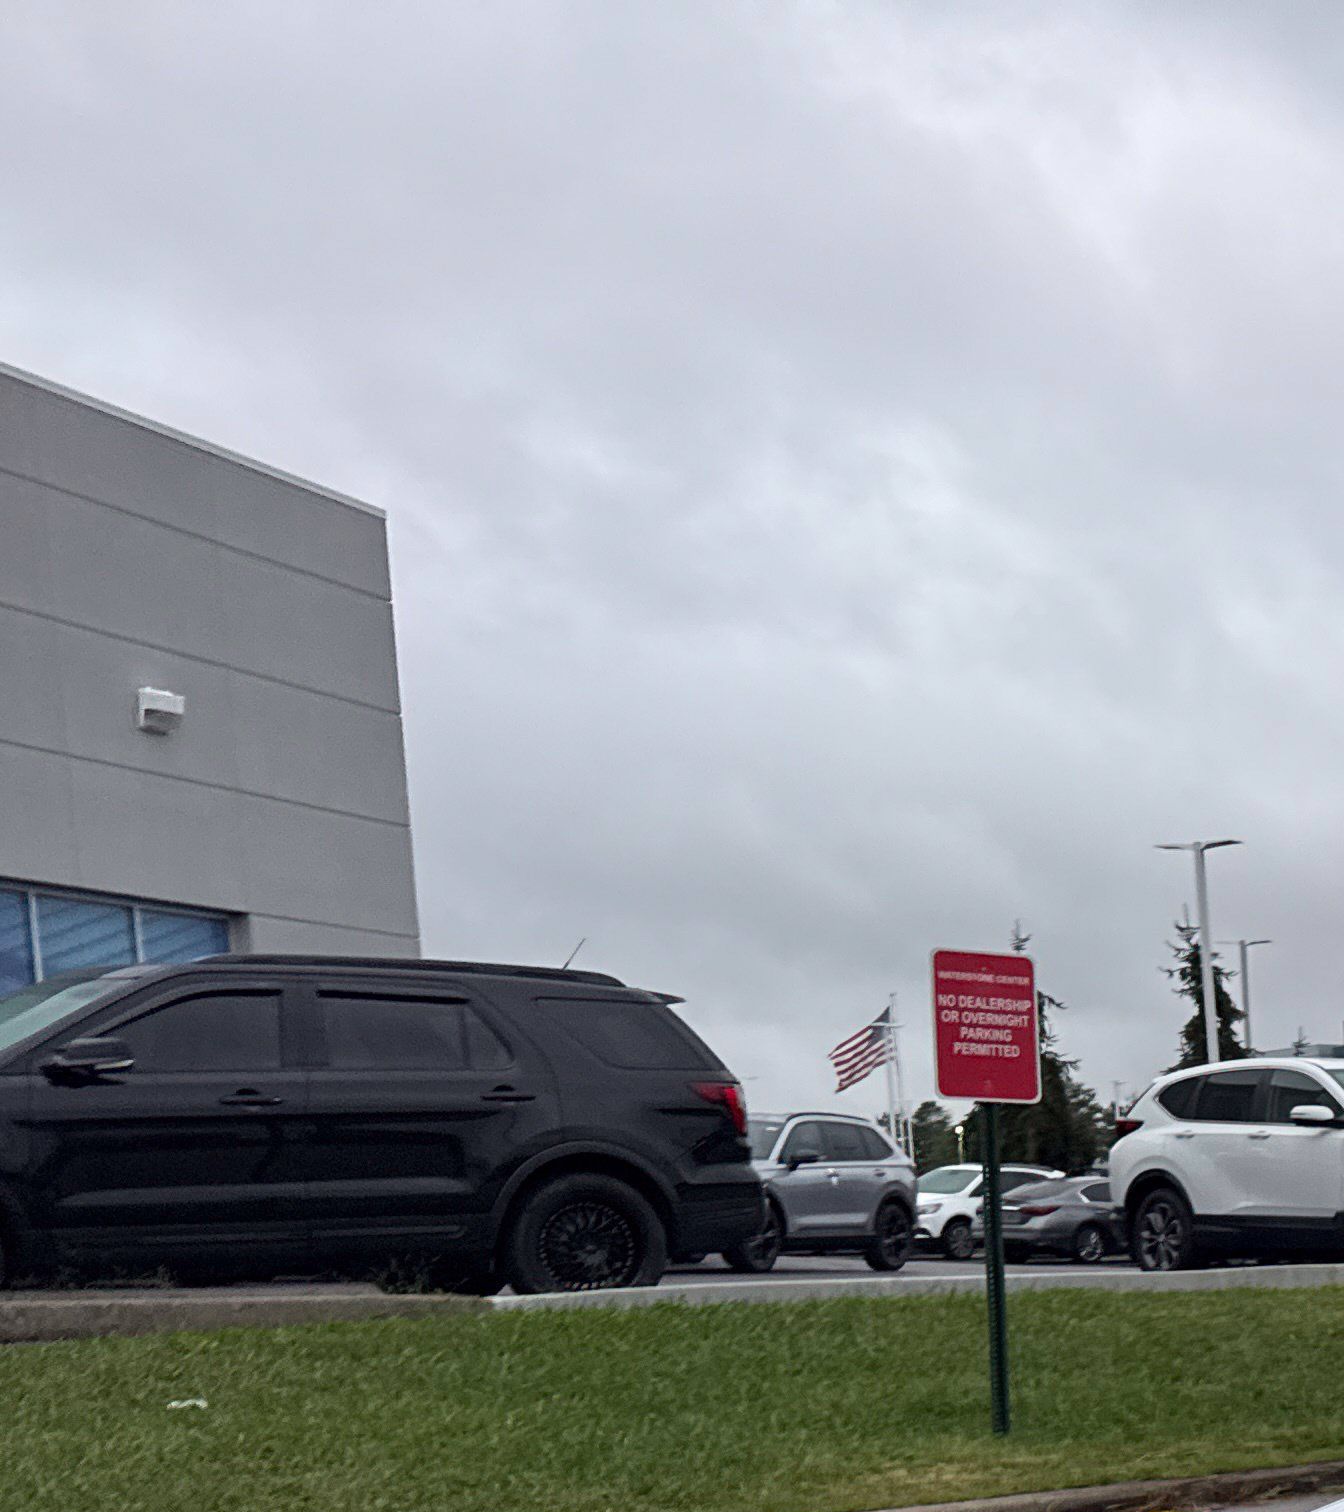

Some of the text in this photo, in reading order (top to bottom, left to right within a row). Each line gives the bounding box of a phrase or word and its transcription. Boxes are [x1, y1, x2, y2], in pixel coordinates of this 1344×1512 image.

[938, 994, 1032, 1012] NO DEALERSHIP
[941, 1010, 1030, 1027] OR OVERNIGHT
[961, 1027, 1012, 1041] PARKING
[954, 1042, 1021, 1057] PERMITTED
